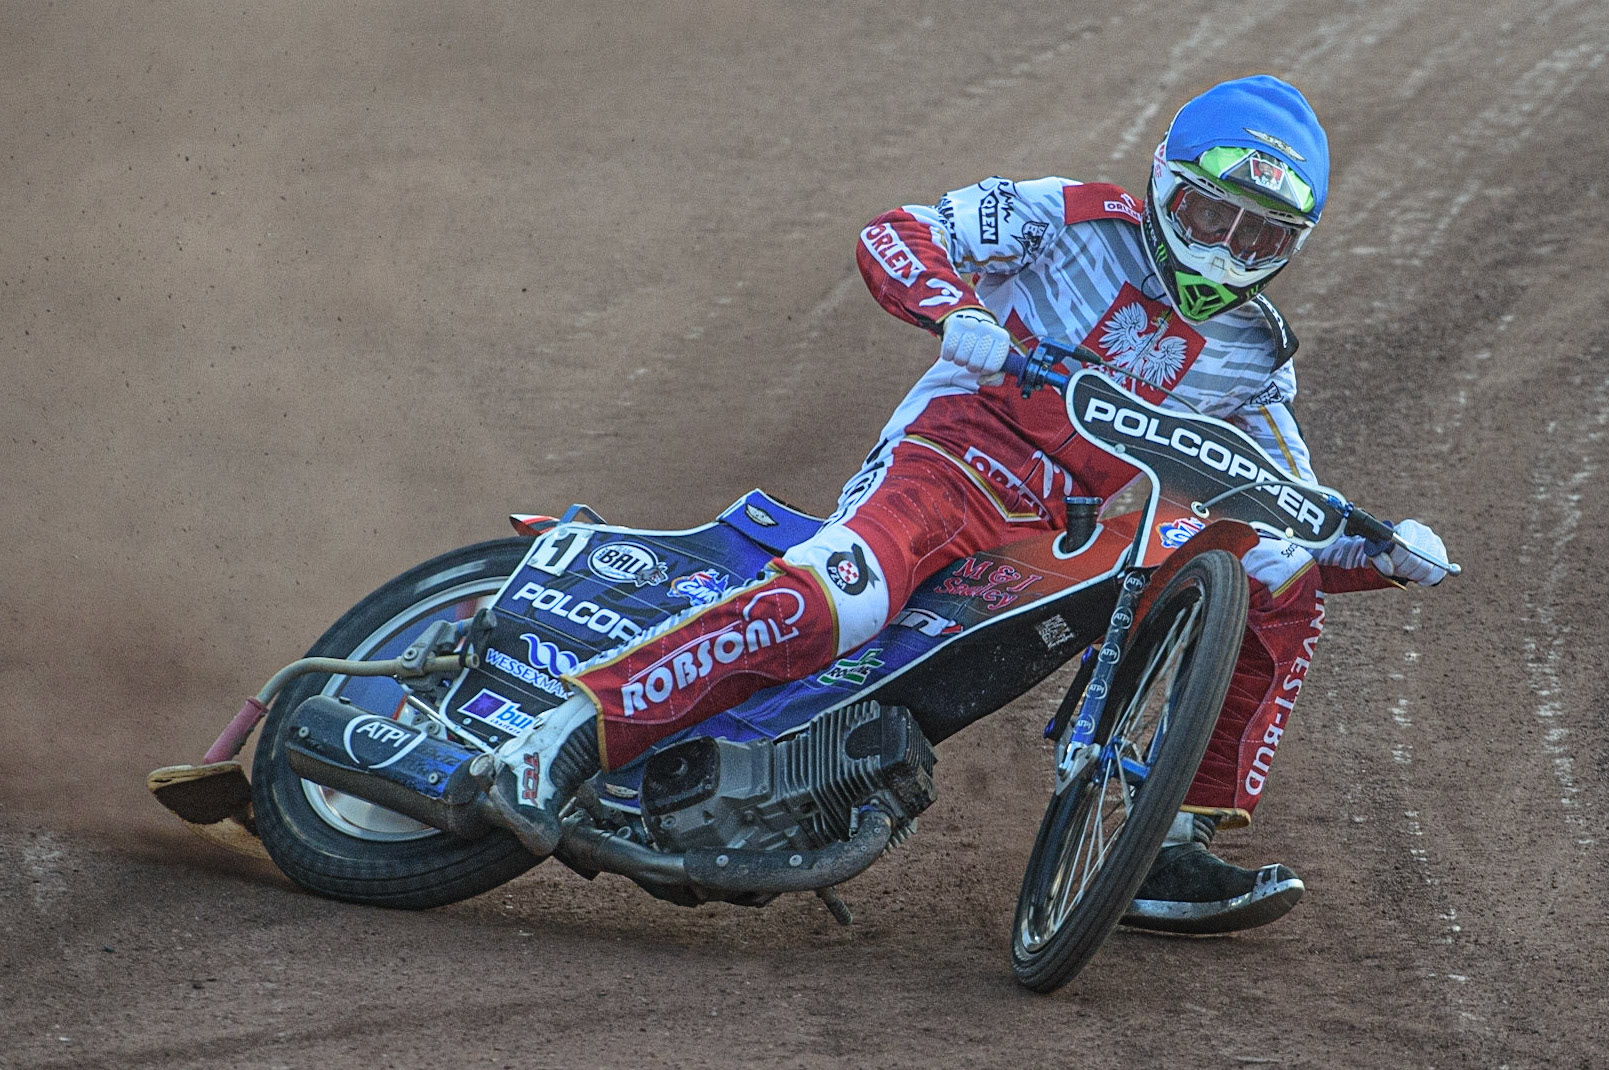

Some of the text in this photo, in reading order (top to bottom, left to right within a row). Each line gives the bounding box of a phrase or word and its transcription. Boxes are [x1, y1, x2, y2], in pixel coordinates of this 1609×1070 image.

[865, 224, 918, 280] ORLEN
[1084, 397, 1326, 536] POLCOPPER
[548, 533, 579, 570] 1
[828, 566, 847, 591] PZM
[952, 557, 994, 580] M
[988, 565, 1022, 585] &
[513, 582, 643, 641] POLCOP
[1113, 611, 1130, 623] ATPI
[1101, 648, 1117, 659] ATPI
[621, 619, 771, 717] ROBSON
[1088, 683, 1104, 694] ATPI
[356, 721, 411, 747] ATPI
